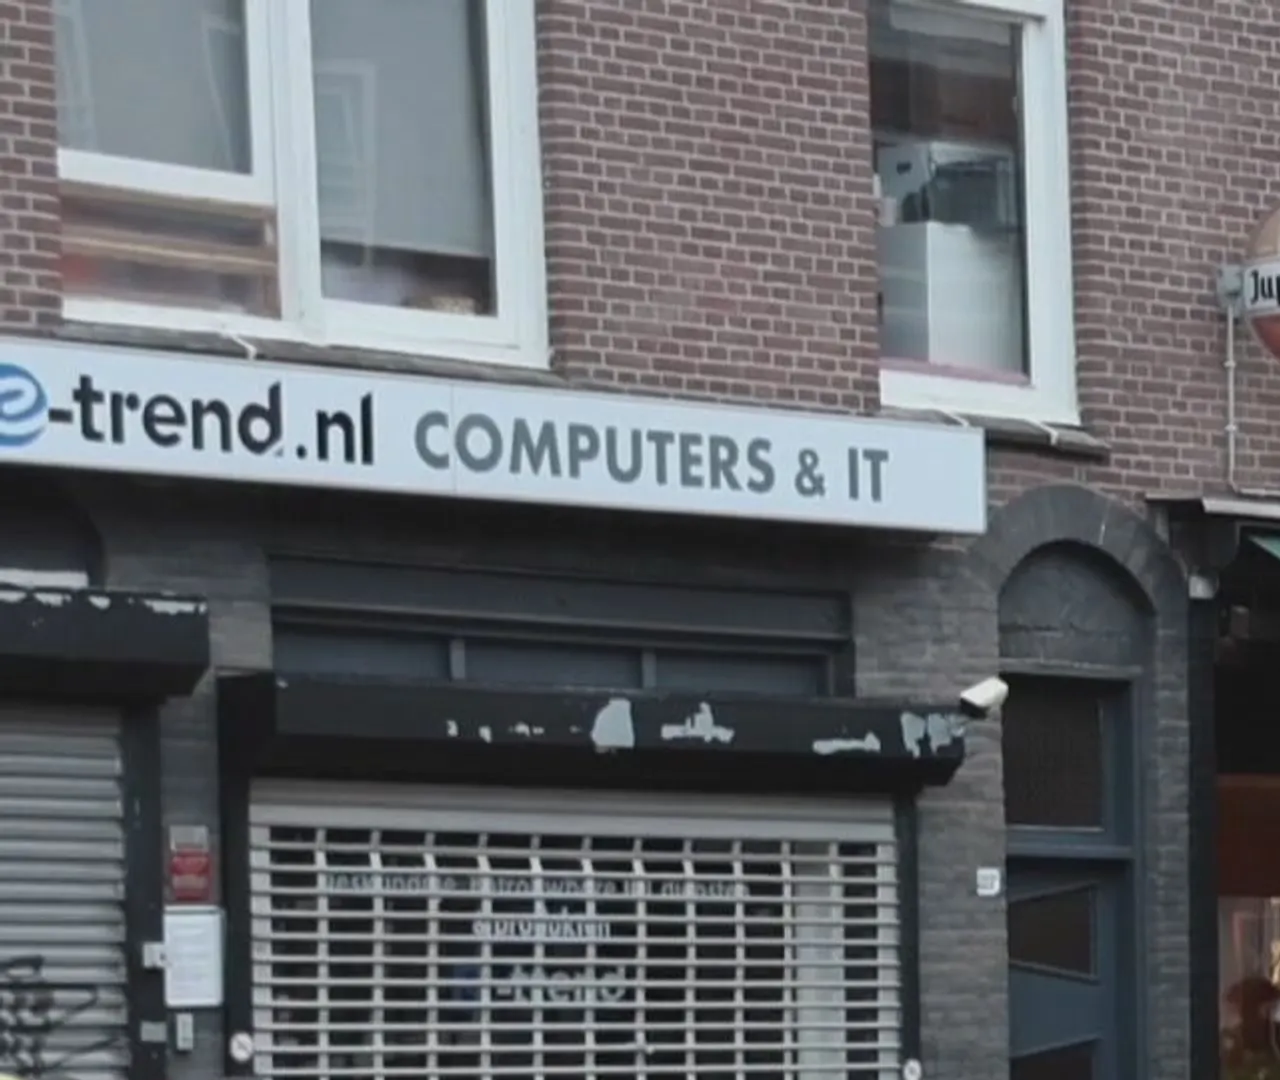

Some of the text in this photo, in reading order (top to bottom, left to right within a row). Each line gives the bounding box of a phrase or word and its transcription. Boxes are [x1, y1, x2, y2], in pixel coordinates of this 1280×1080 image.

[0, 363, 890, 502] e-trend.nl COMPUTERS & IT
